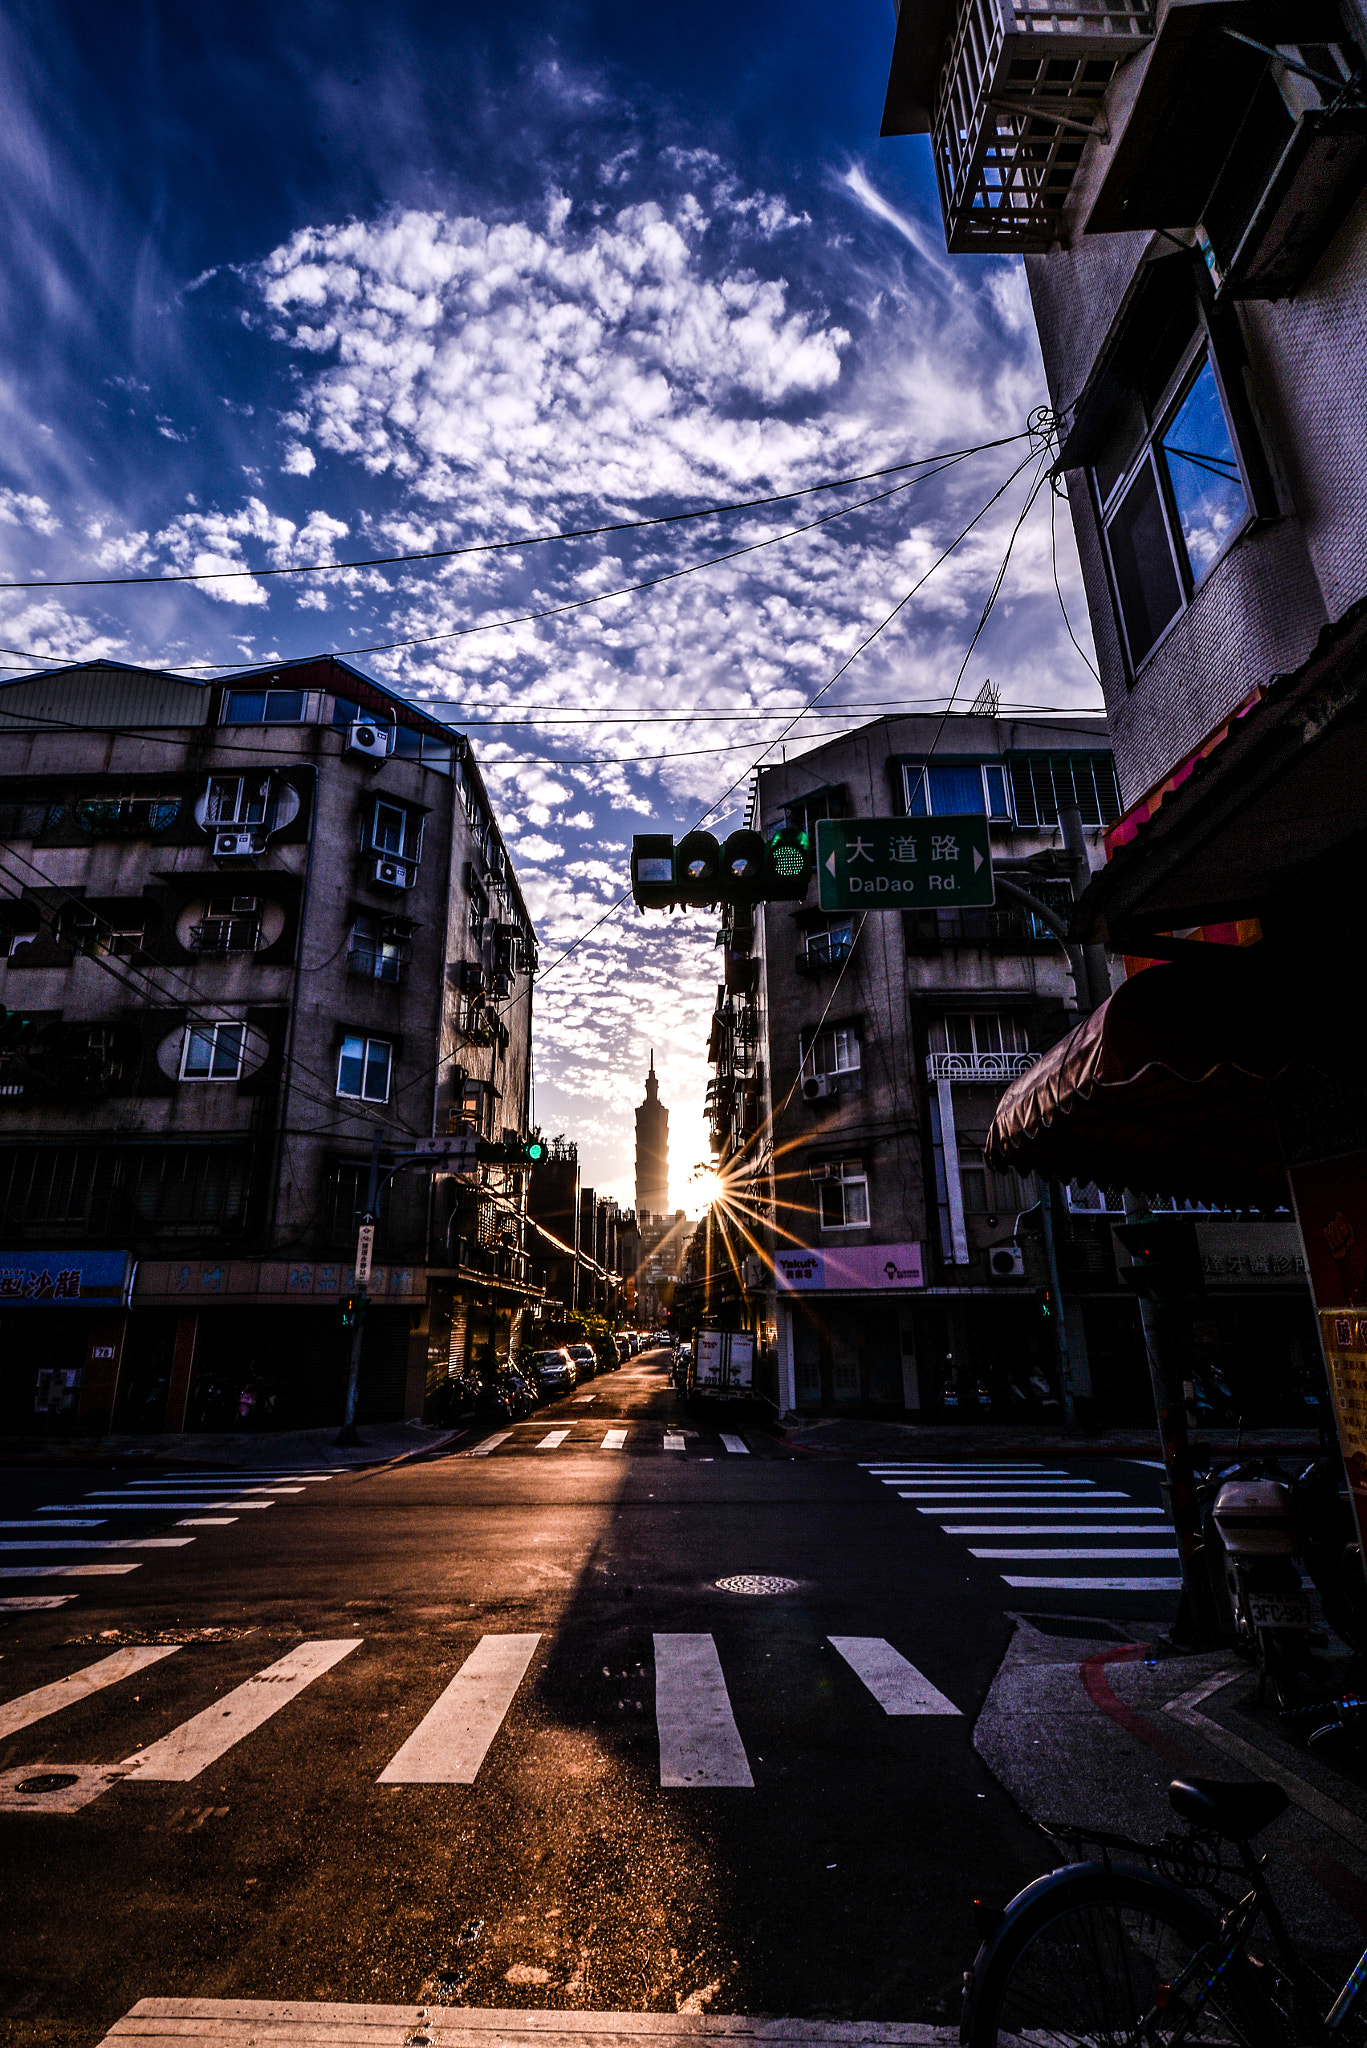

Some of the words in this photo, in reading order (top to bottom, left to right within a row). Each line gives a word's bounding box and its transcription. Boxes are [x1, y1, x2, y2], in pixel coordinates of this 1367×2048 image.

[845, 835, 960, 864] 大道路
[849, 875, 914, 893] DaDao
[929, 874, 961, 891] Rd.
[779, 1258, 818, 1269] Yakult
